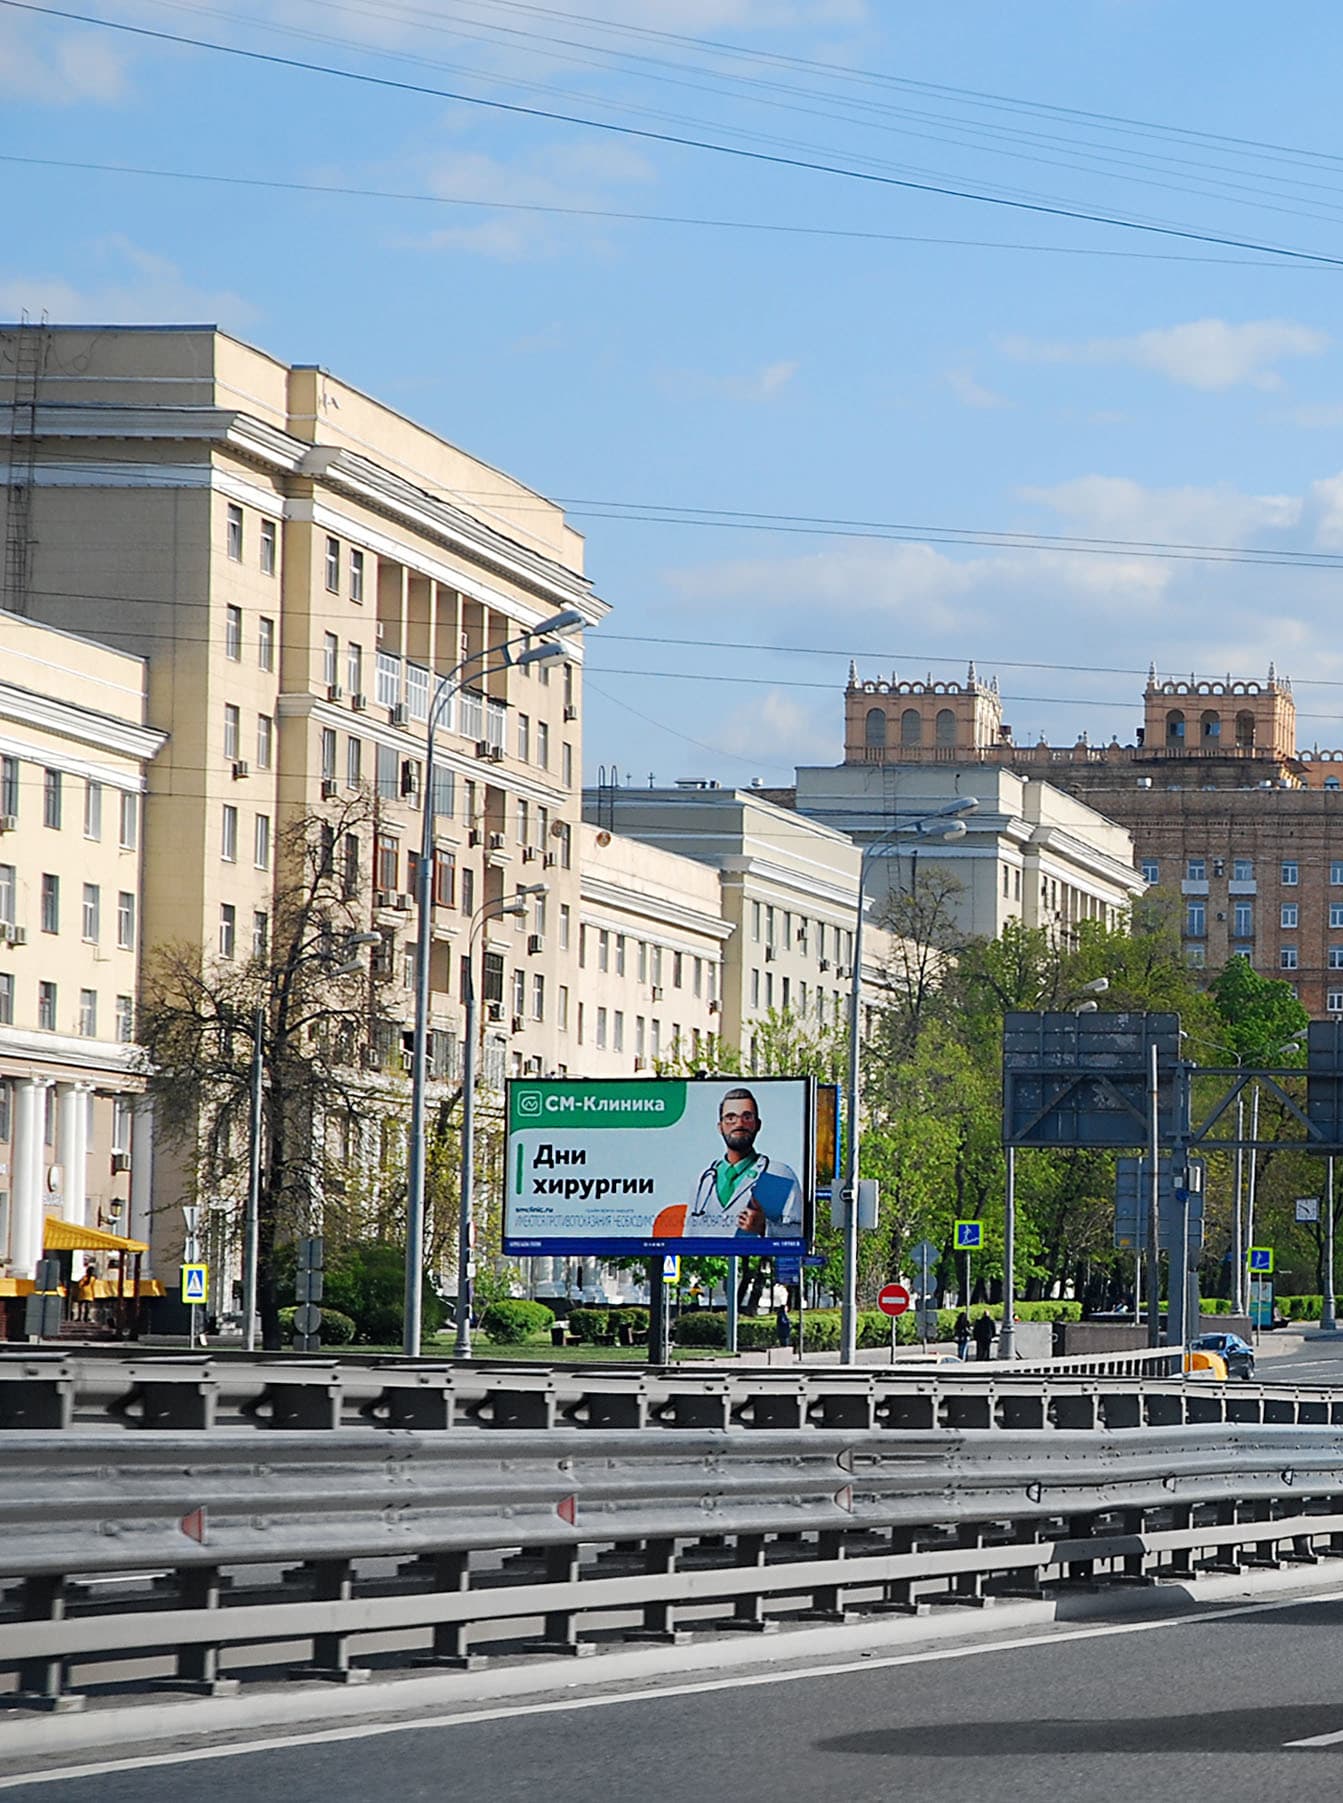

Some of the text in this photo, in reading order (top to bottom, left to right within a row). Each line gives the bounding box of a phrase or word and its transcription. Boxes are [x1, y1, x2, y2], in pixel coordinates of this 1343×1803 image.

[545, 1095, 665, 1112] СМ-Клиника
[533, 1144, 586, 1169] Дни
[533, 1176, 654, 1200] хирургии
